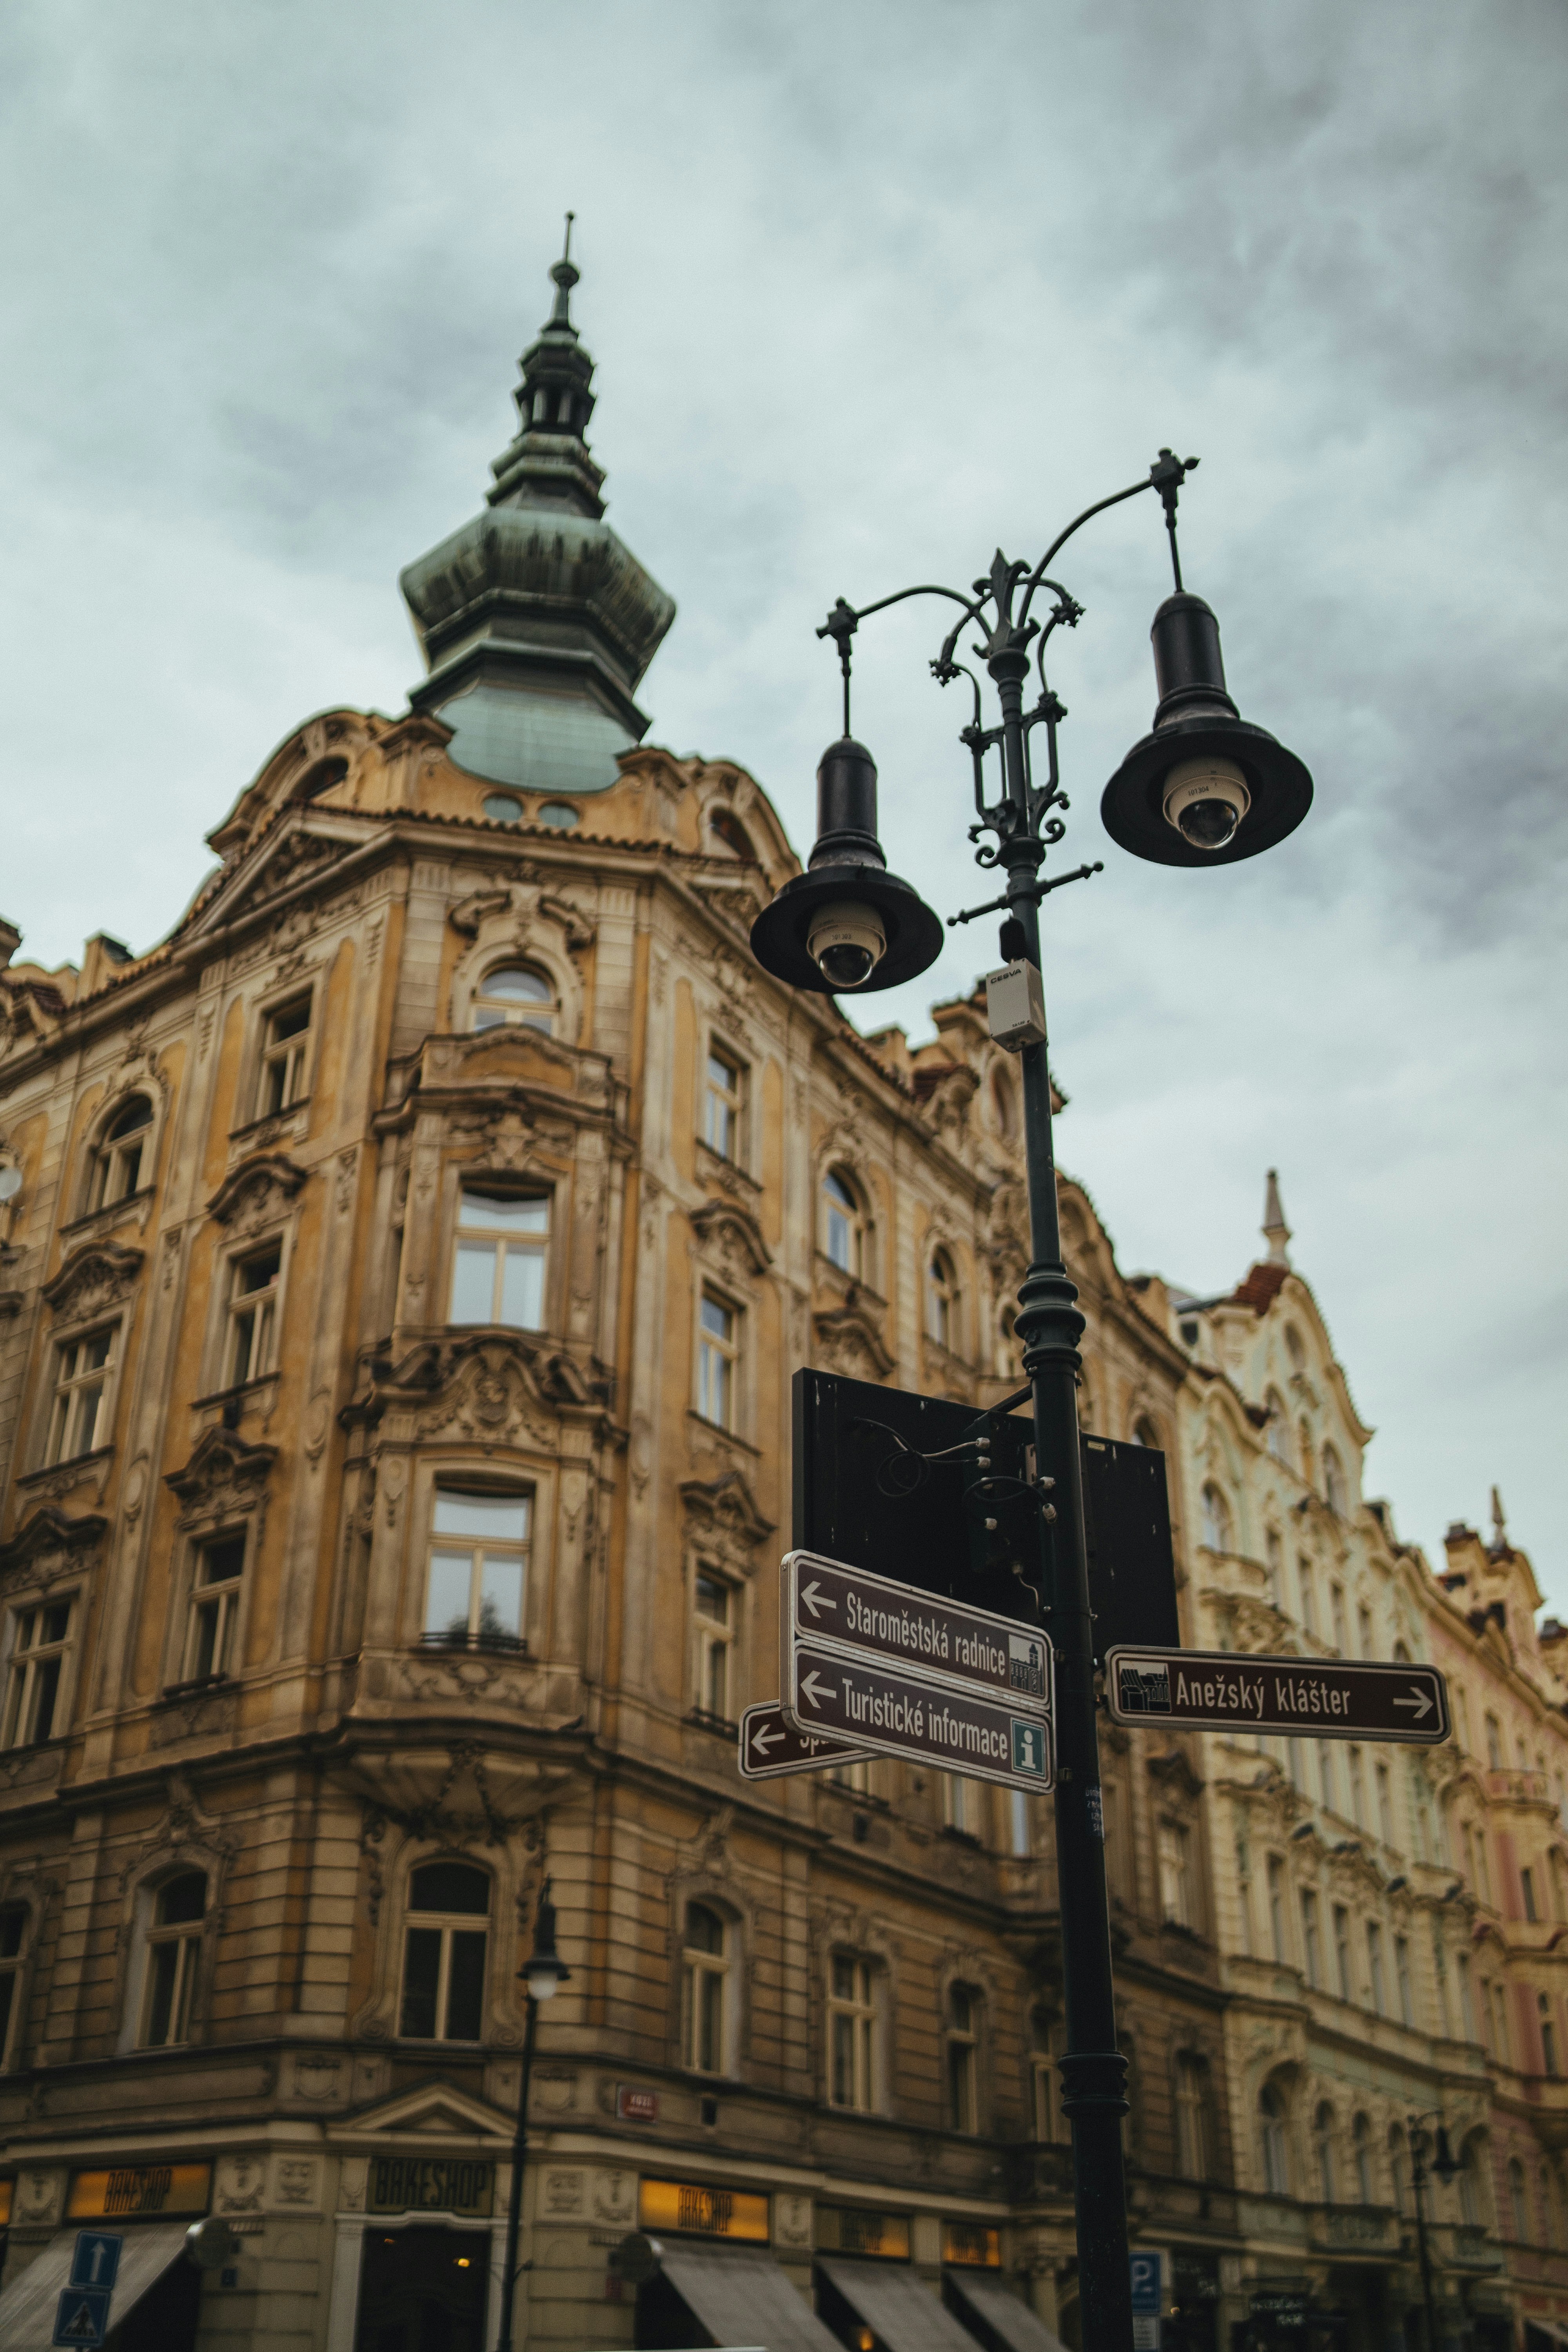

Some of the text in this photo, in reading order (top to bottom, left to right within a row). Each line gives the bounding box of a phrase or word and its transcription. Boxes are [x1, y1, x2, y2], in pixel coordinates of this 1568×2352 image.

[991, 968, 1022, 984] CESVA
[847, 1592, 1005, 1676] Staroměstská radnice
[842, 1678, 1008, 1760] Turistické informace
[1176, 1672, 1350, 1719] Anežský klášter
[375, 2160, 487, 2208] BAKESHOP
